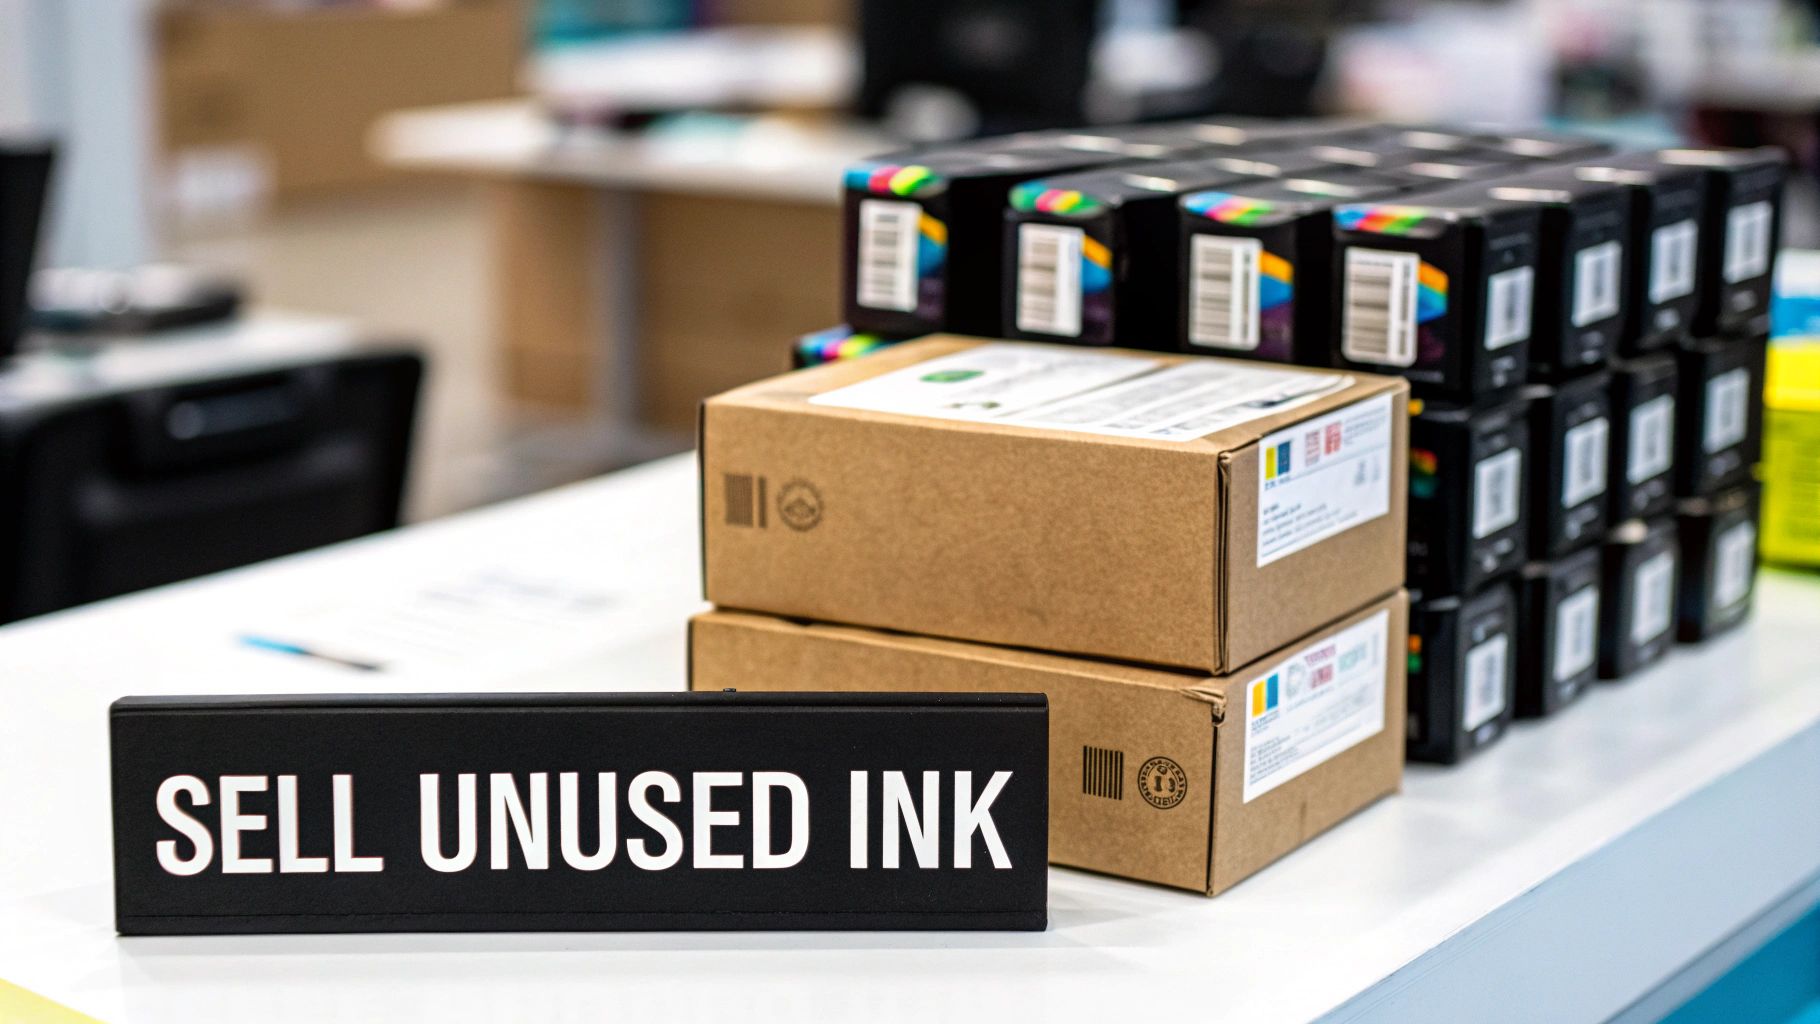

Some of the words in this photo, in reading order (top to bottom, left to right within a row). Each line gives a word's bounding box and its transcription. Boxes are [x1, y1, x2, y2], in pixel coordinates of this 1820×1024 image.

[156, 773, 384, 876] SELL
[419, 770, 810, 871] UNUSED
[850, 769, 1014, 869] INK
